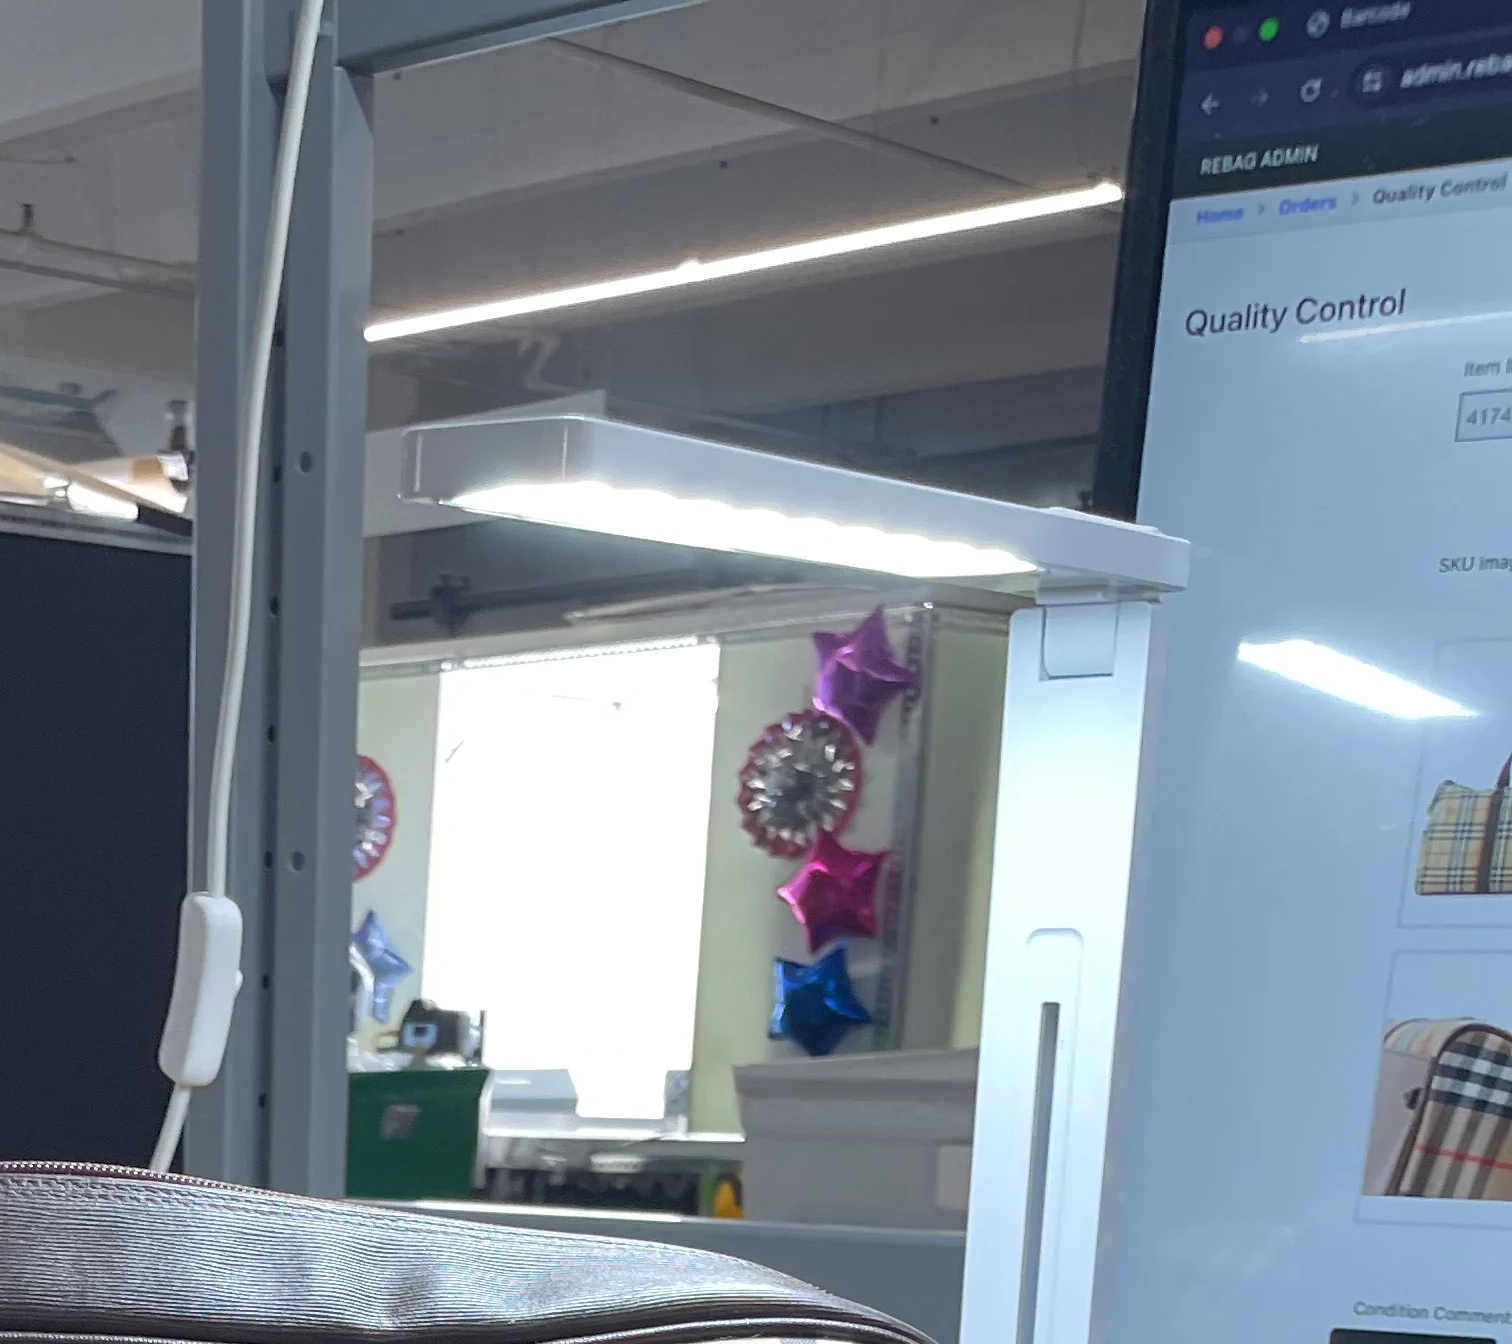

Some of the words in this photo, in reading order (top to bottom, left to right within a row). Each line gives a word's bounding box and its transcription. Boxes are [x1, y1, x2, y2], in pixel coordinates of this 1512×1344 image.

[1260, 144, 1320, 168] ADMIN
[1196, 208, 1245, 225] Home
[1279, 196, 1337, 216] Orders
[1373, 183, 1437, 205] Quality
[1440, 172, 1508, 197] Control
[1185, 301, 1288, 337] Quality
[1295, 288, 1407, 325] Control
[1463, 361, 1500, 377] Item
[1439, 556, 1475, 573] SKU
[1353, 1301, 1429, 1320] Condition
